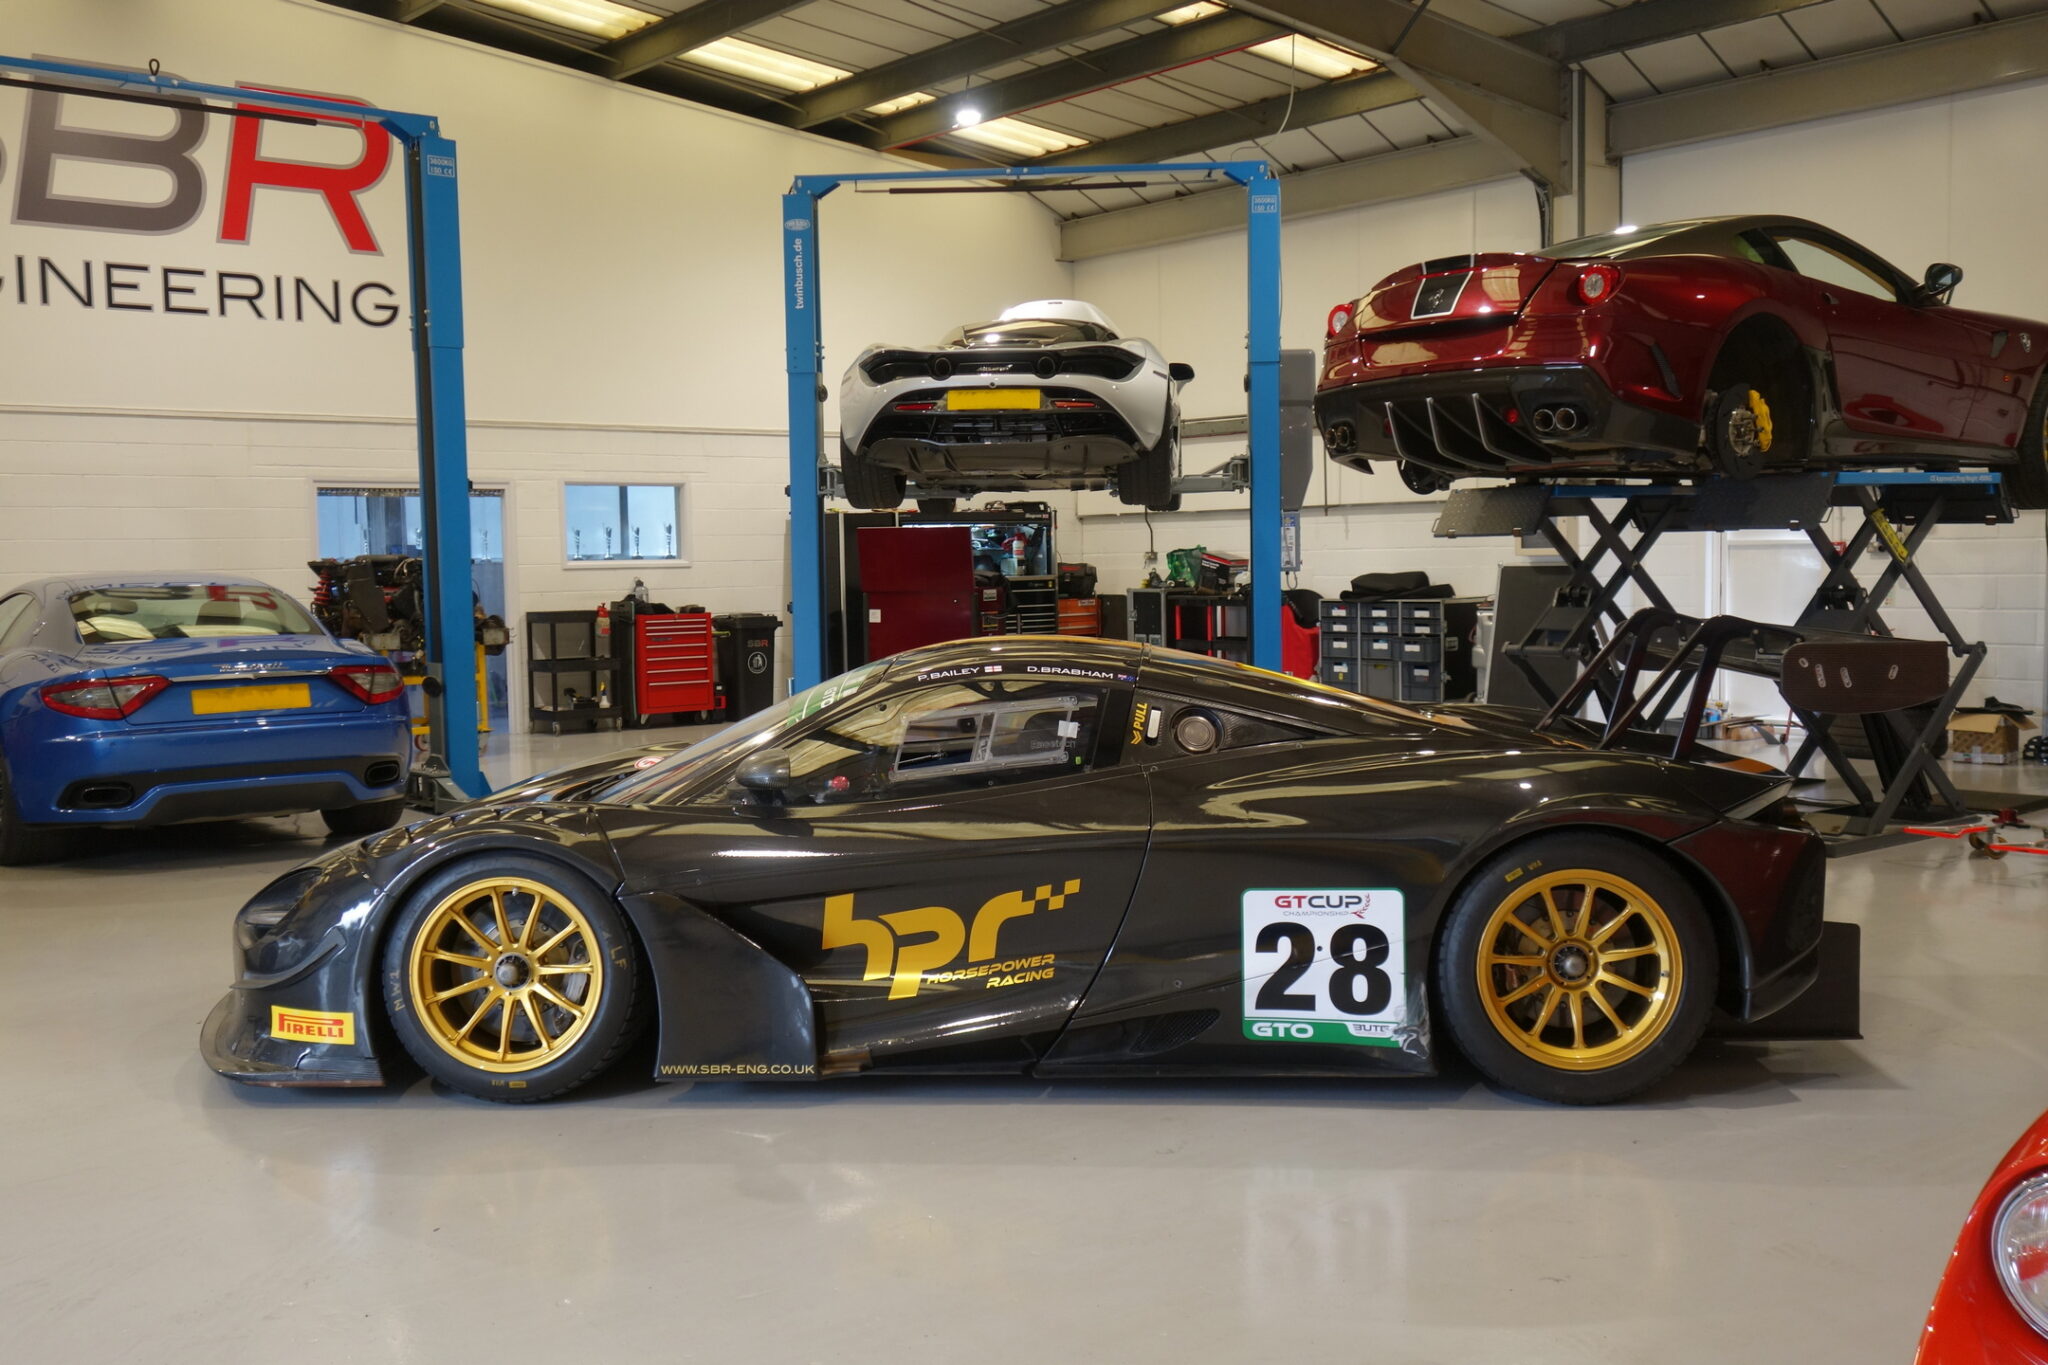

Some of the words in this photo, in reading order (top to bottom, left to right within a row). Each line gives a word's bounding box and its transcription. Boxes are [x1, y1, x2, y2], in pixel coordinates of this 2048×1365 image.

[0, 53, 394, 257] BR
[793, 238, 804, 309] twinbusch.de
[0, 254, 400, 328] INEERING
[917, 666, 980, 682] P.BAILEY
[1027, 665, 1114, 679] D.BRABHAM
[1134, 702, 1148, 730] PULL
[1282, 910, 1350, 918] CHAMPIONSHIP
[926, 954, 1055, 985] HORSEPOWER
[986, 967, 1055, 989] RACING
[1255, 921, 1392, 1016] 28
[278, 1012, 345, 1039] PIRELLI
[1252, 1022, 1314, 1039] GTO
[661, 1064, 816, 1076] WWW.SBR-ENG.CO.UK
